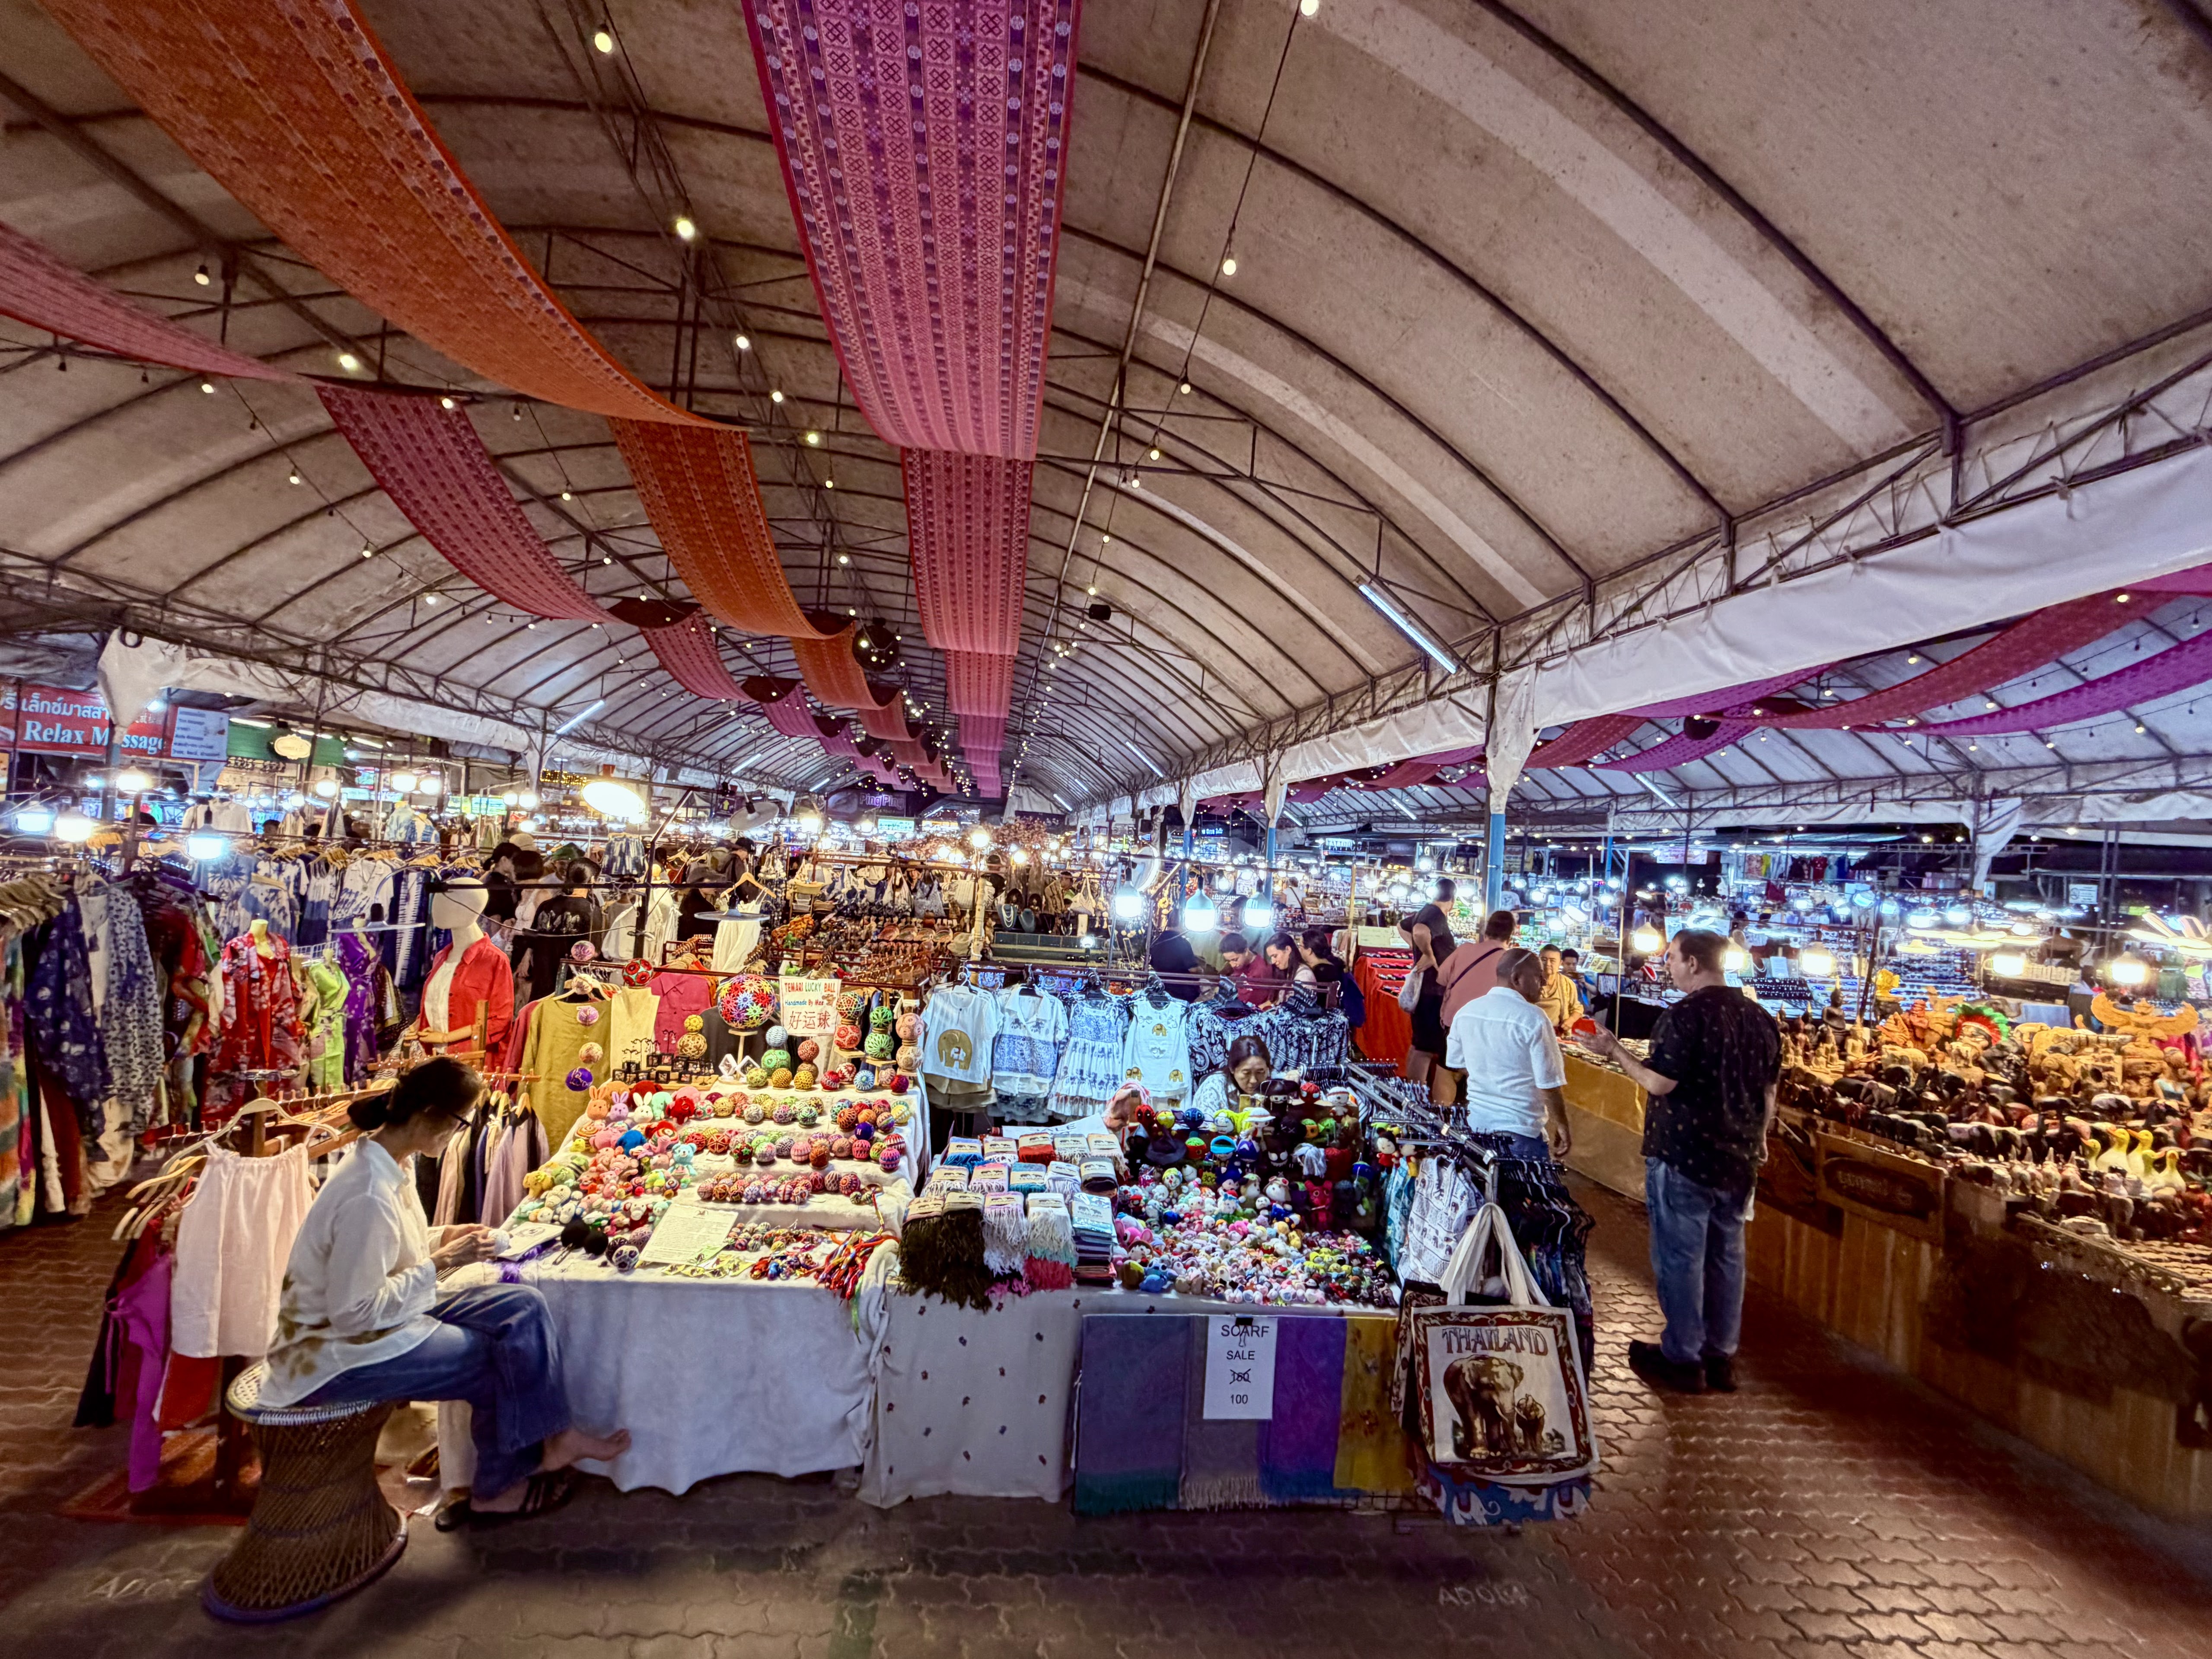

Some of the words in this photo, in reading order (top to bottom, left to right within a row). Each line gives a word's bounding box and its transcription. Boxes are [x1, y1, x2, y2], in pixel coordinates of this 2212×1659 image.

[24, 721, 84, 745] Relax
[91, 727, 163, 754] Mssag
[860, 793, 882, 807] Ping
[883, 794, 904, 810] Ping
[784, 982, 803, 992] TEMARI
[805, 982, 821, 992] LUCKY
[824, 983, 835, 992] BALL
[788, 1011, 831, 1030] 好运球
[1202, 1174, 1215, 1184] 300
[1442, 1327, 1548, 1356] THAILAND
[1226, 1350, 1256, 1360] SALE
[1230, 1394, 1248, 1404] 100
